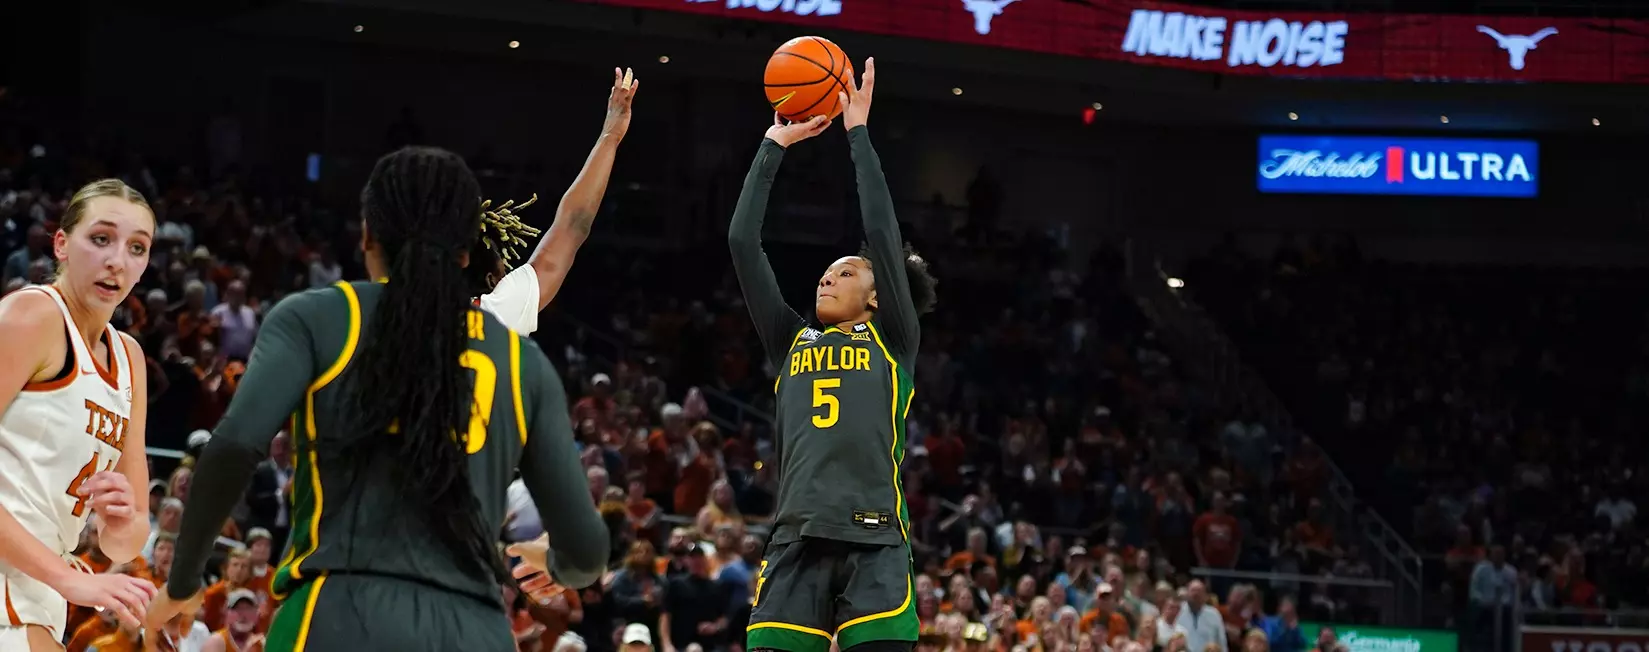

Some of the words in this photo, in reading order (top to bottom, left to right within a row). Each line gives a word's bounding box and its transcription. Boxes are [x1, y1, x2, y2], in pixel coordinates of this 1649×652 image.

[1121, 9, 1227, 60] MAKE
[1227, 18, 1349, 67] NOISE
[1259, 148, 1383, 179] Michelob
[1411, 151, 1531, 181] ULTRA
[789, 345, 871, 377] BAYLOR
[811, 378, 841, 429] 5
